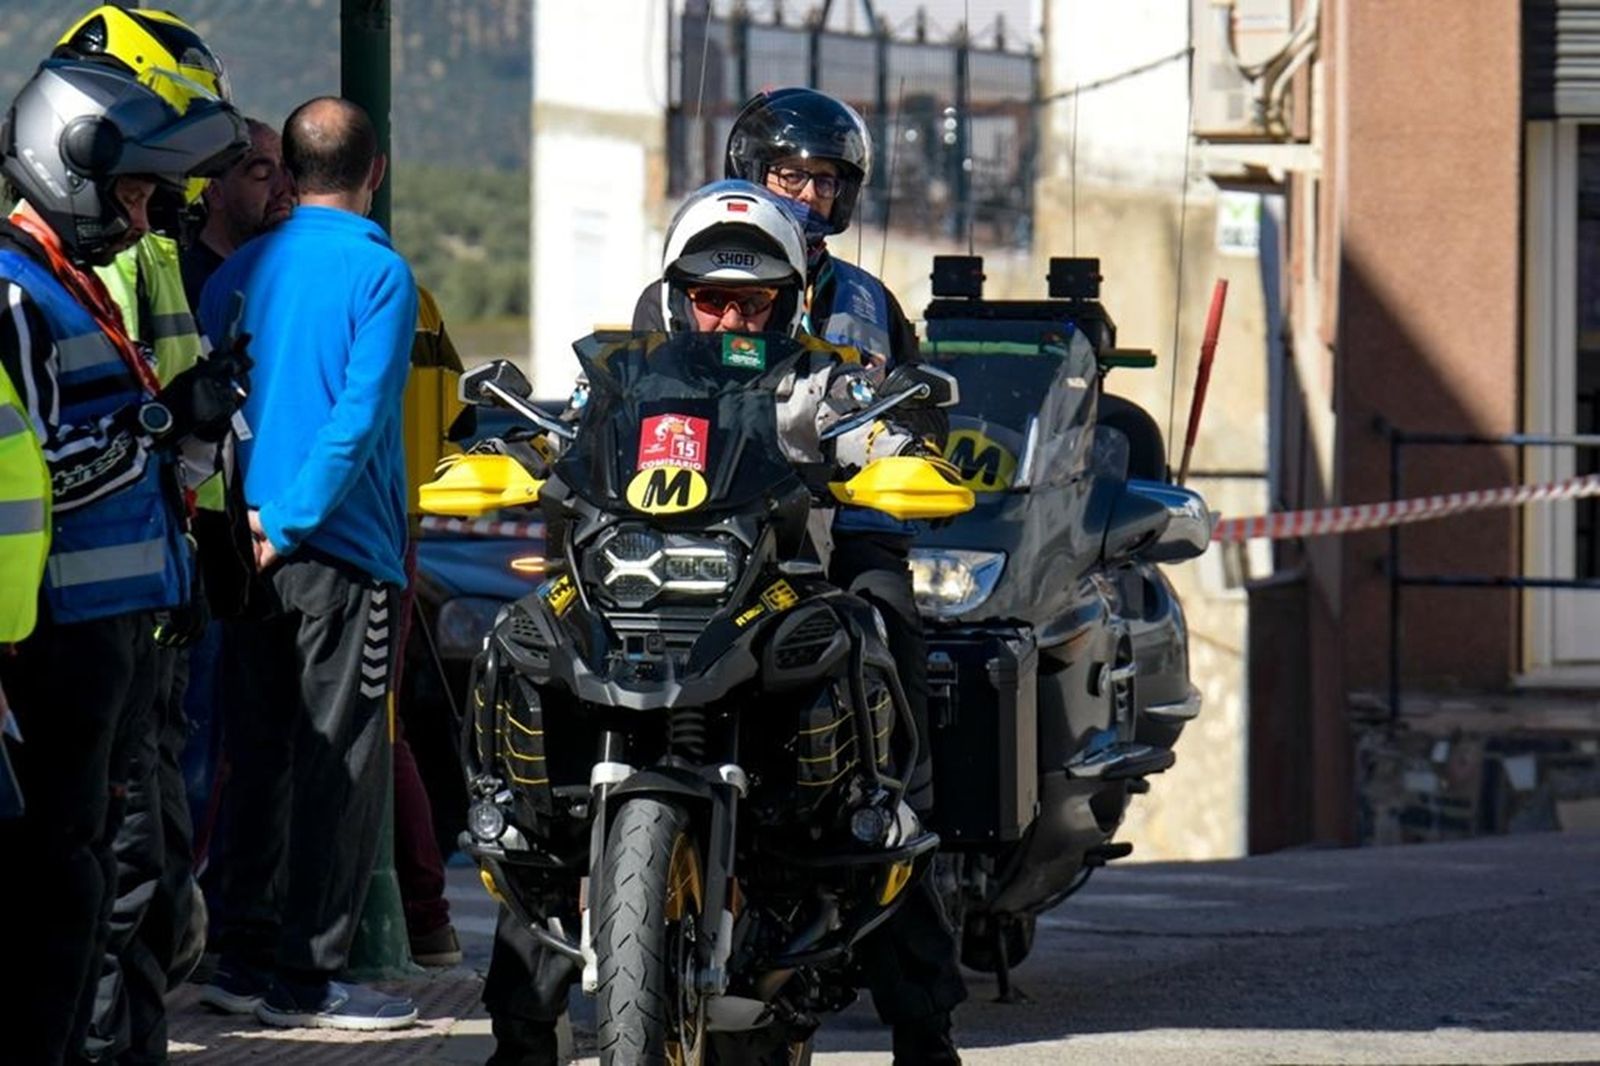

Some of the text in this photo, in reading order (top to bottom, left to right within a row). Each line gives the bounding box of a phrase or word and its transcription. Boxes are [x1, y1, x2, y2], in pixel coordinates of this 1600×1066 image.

[717, 252, 755, 266] SHOEI
[677, 441, 695, 457] 15
[641, 459, 702, 469] COMISARIO
[948, 436, 1001, 487] M
[641, 469, 693, 508] M
